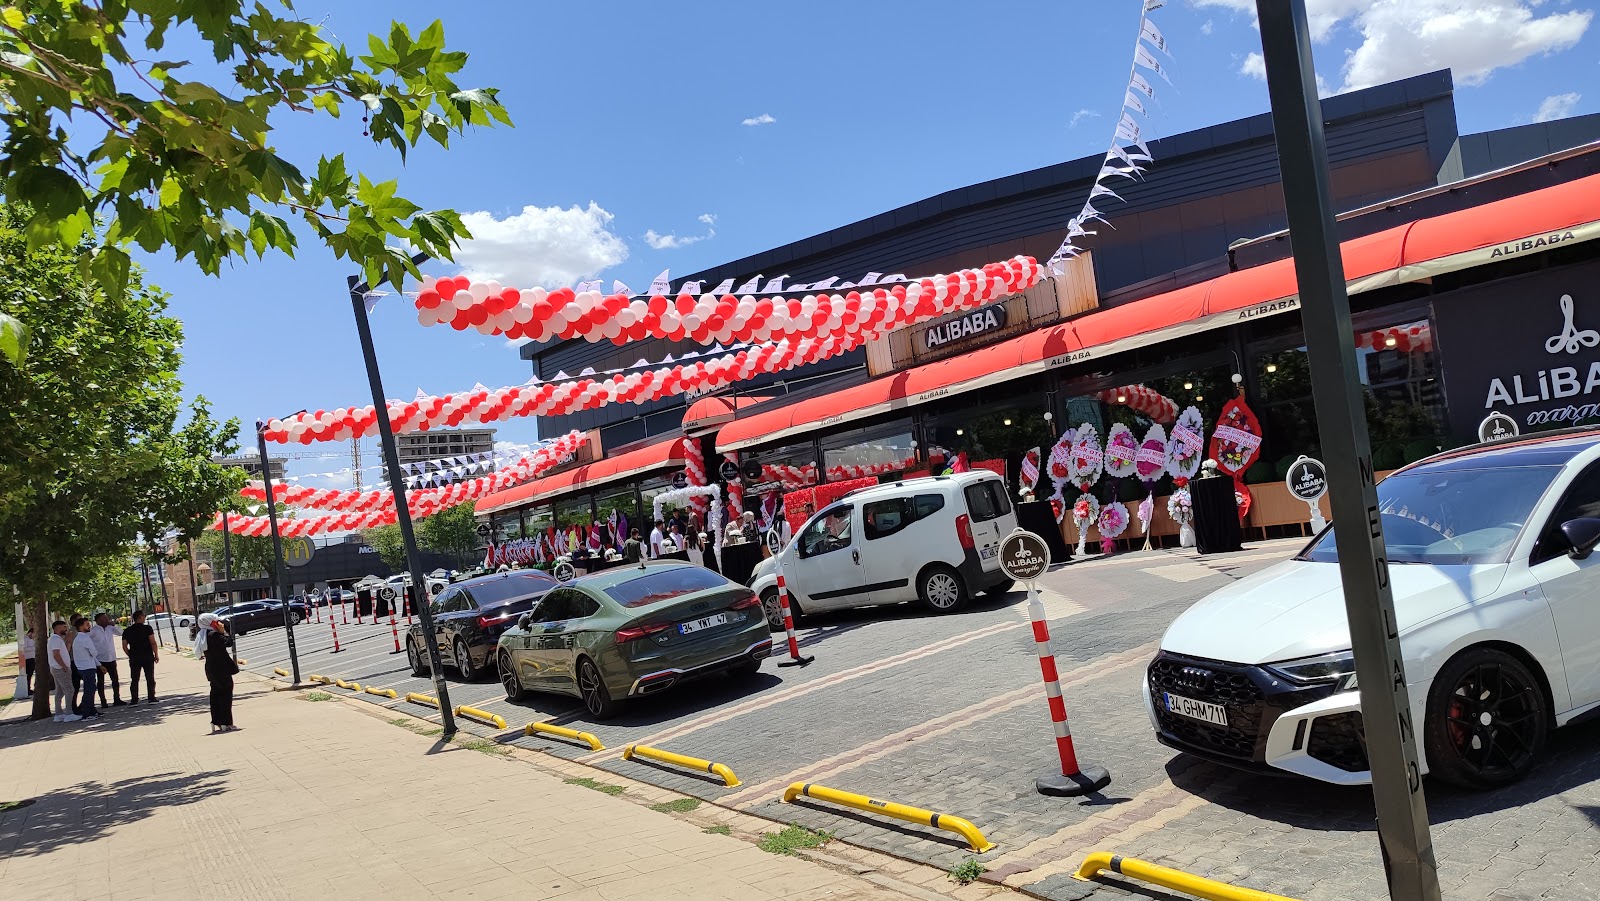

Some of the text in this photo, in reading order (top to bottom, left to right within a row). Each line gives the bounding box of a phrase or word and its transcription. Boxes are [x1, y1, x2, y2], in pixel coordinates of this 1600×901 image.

[1484, 361, 1600, 409] ALiBA
[682, 613, 725, 633] 34 YNT 47
